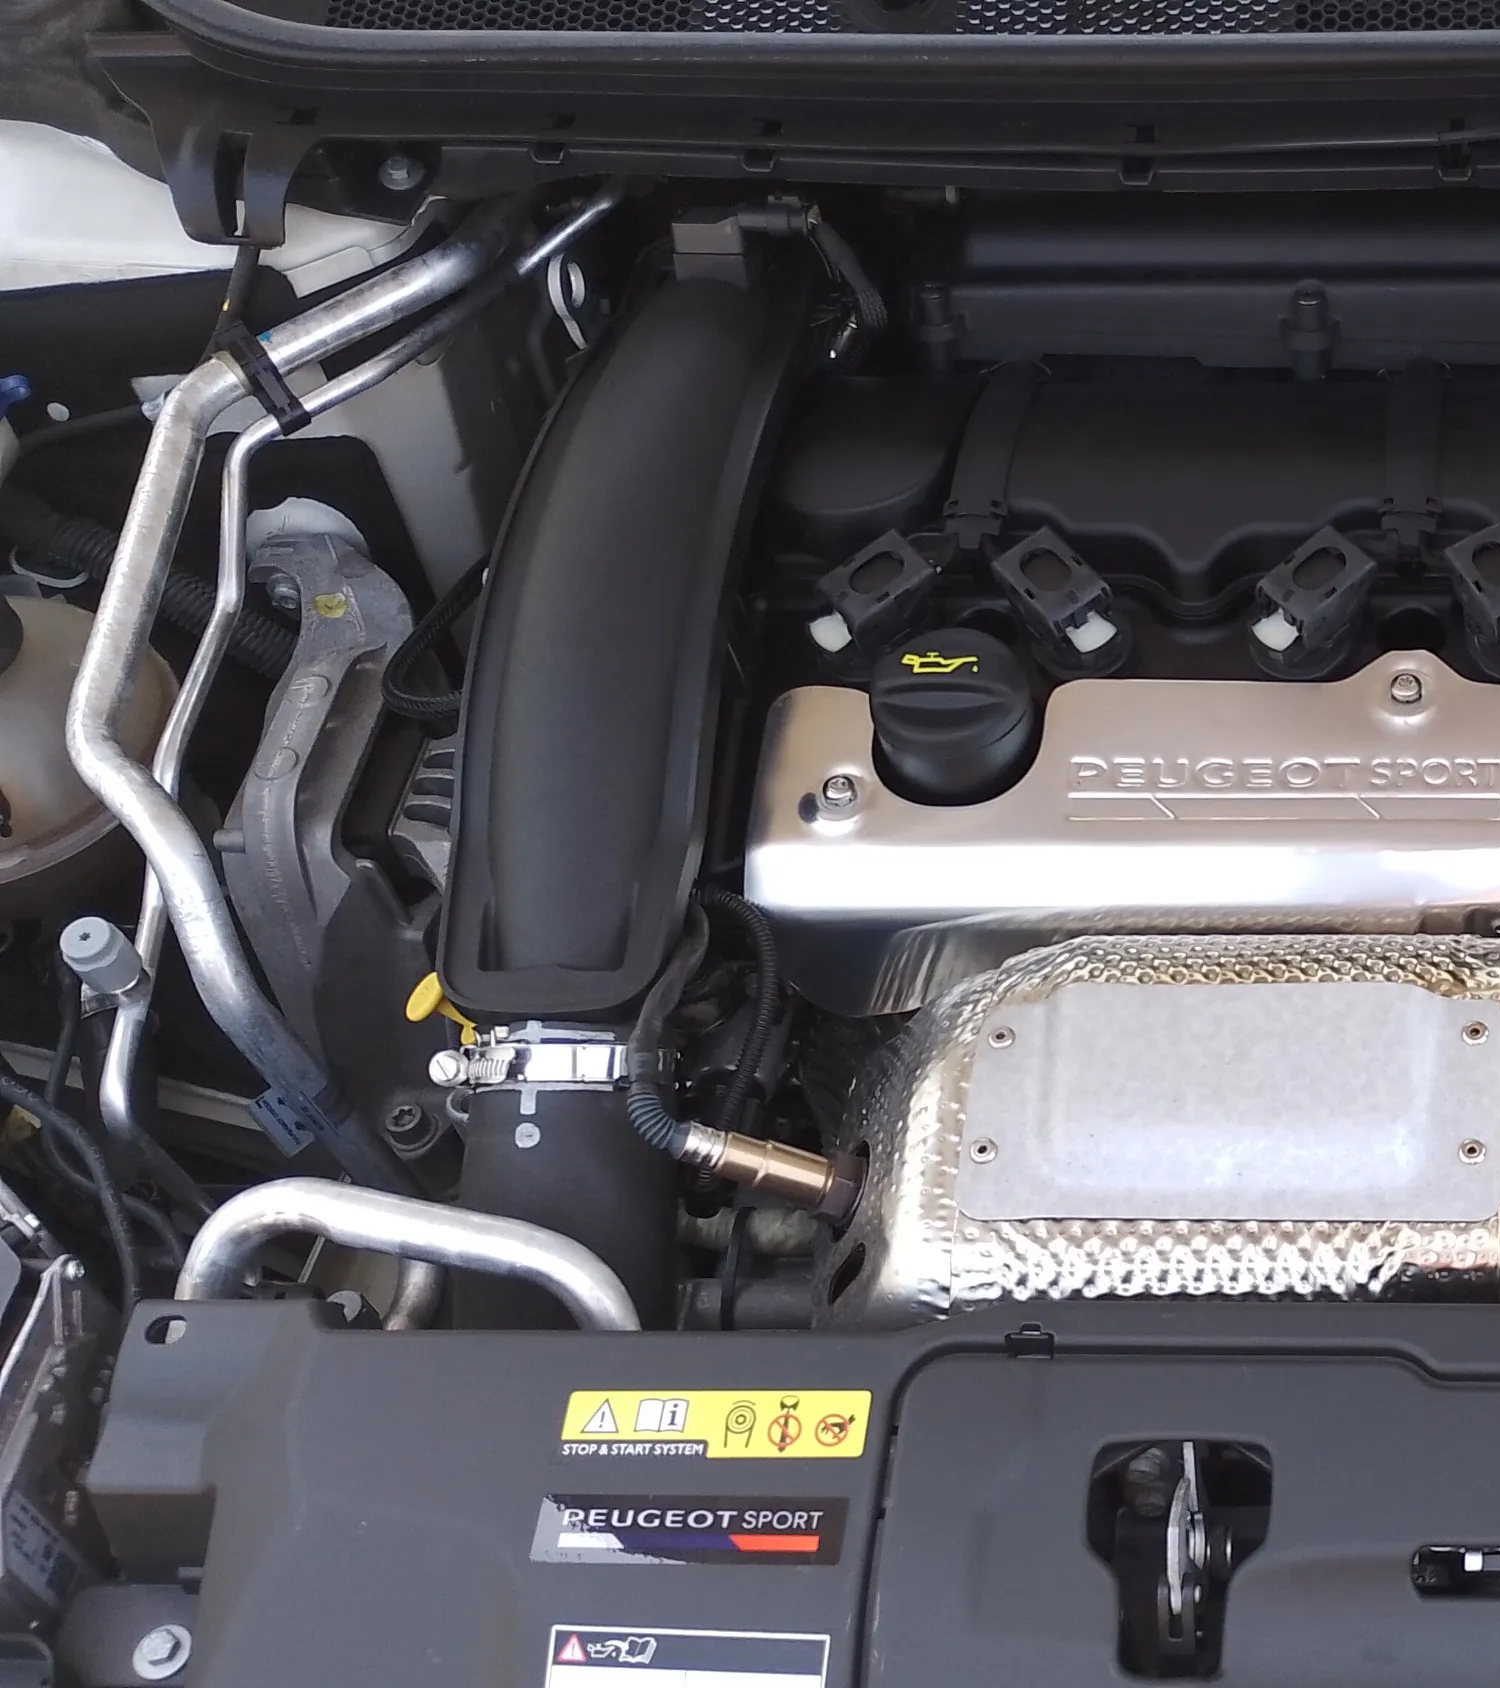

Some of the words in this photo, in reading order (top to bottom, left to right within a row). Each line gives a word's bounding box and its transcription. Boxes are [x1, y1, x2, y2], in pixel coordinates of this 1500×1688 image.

[1070, 756, 1361, 788] PEUGEOT
[561, 1443, 598, 1455] STOP
[598, 1444, 609, 1455] &
[610, 1443, 652, 1456] START
[652, 1443, 704, 1456] SYSTEM
[562, 1508, 738, 1529] PEUGEOT
[741, 1510, 824, 1530] SPORT
